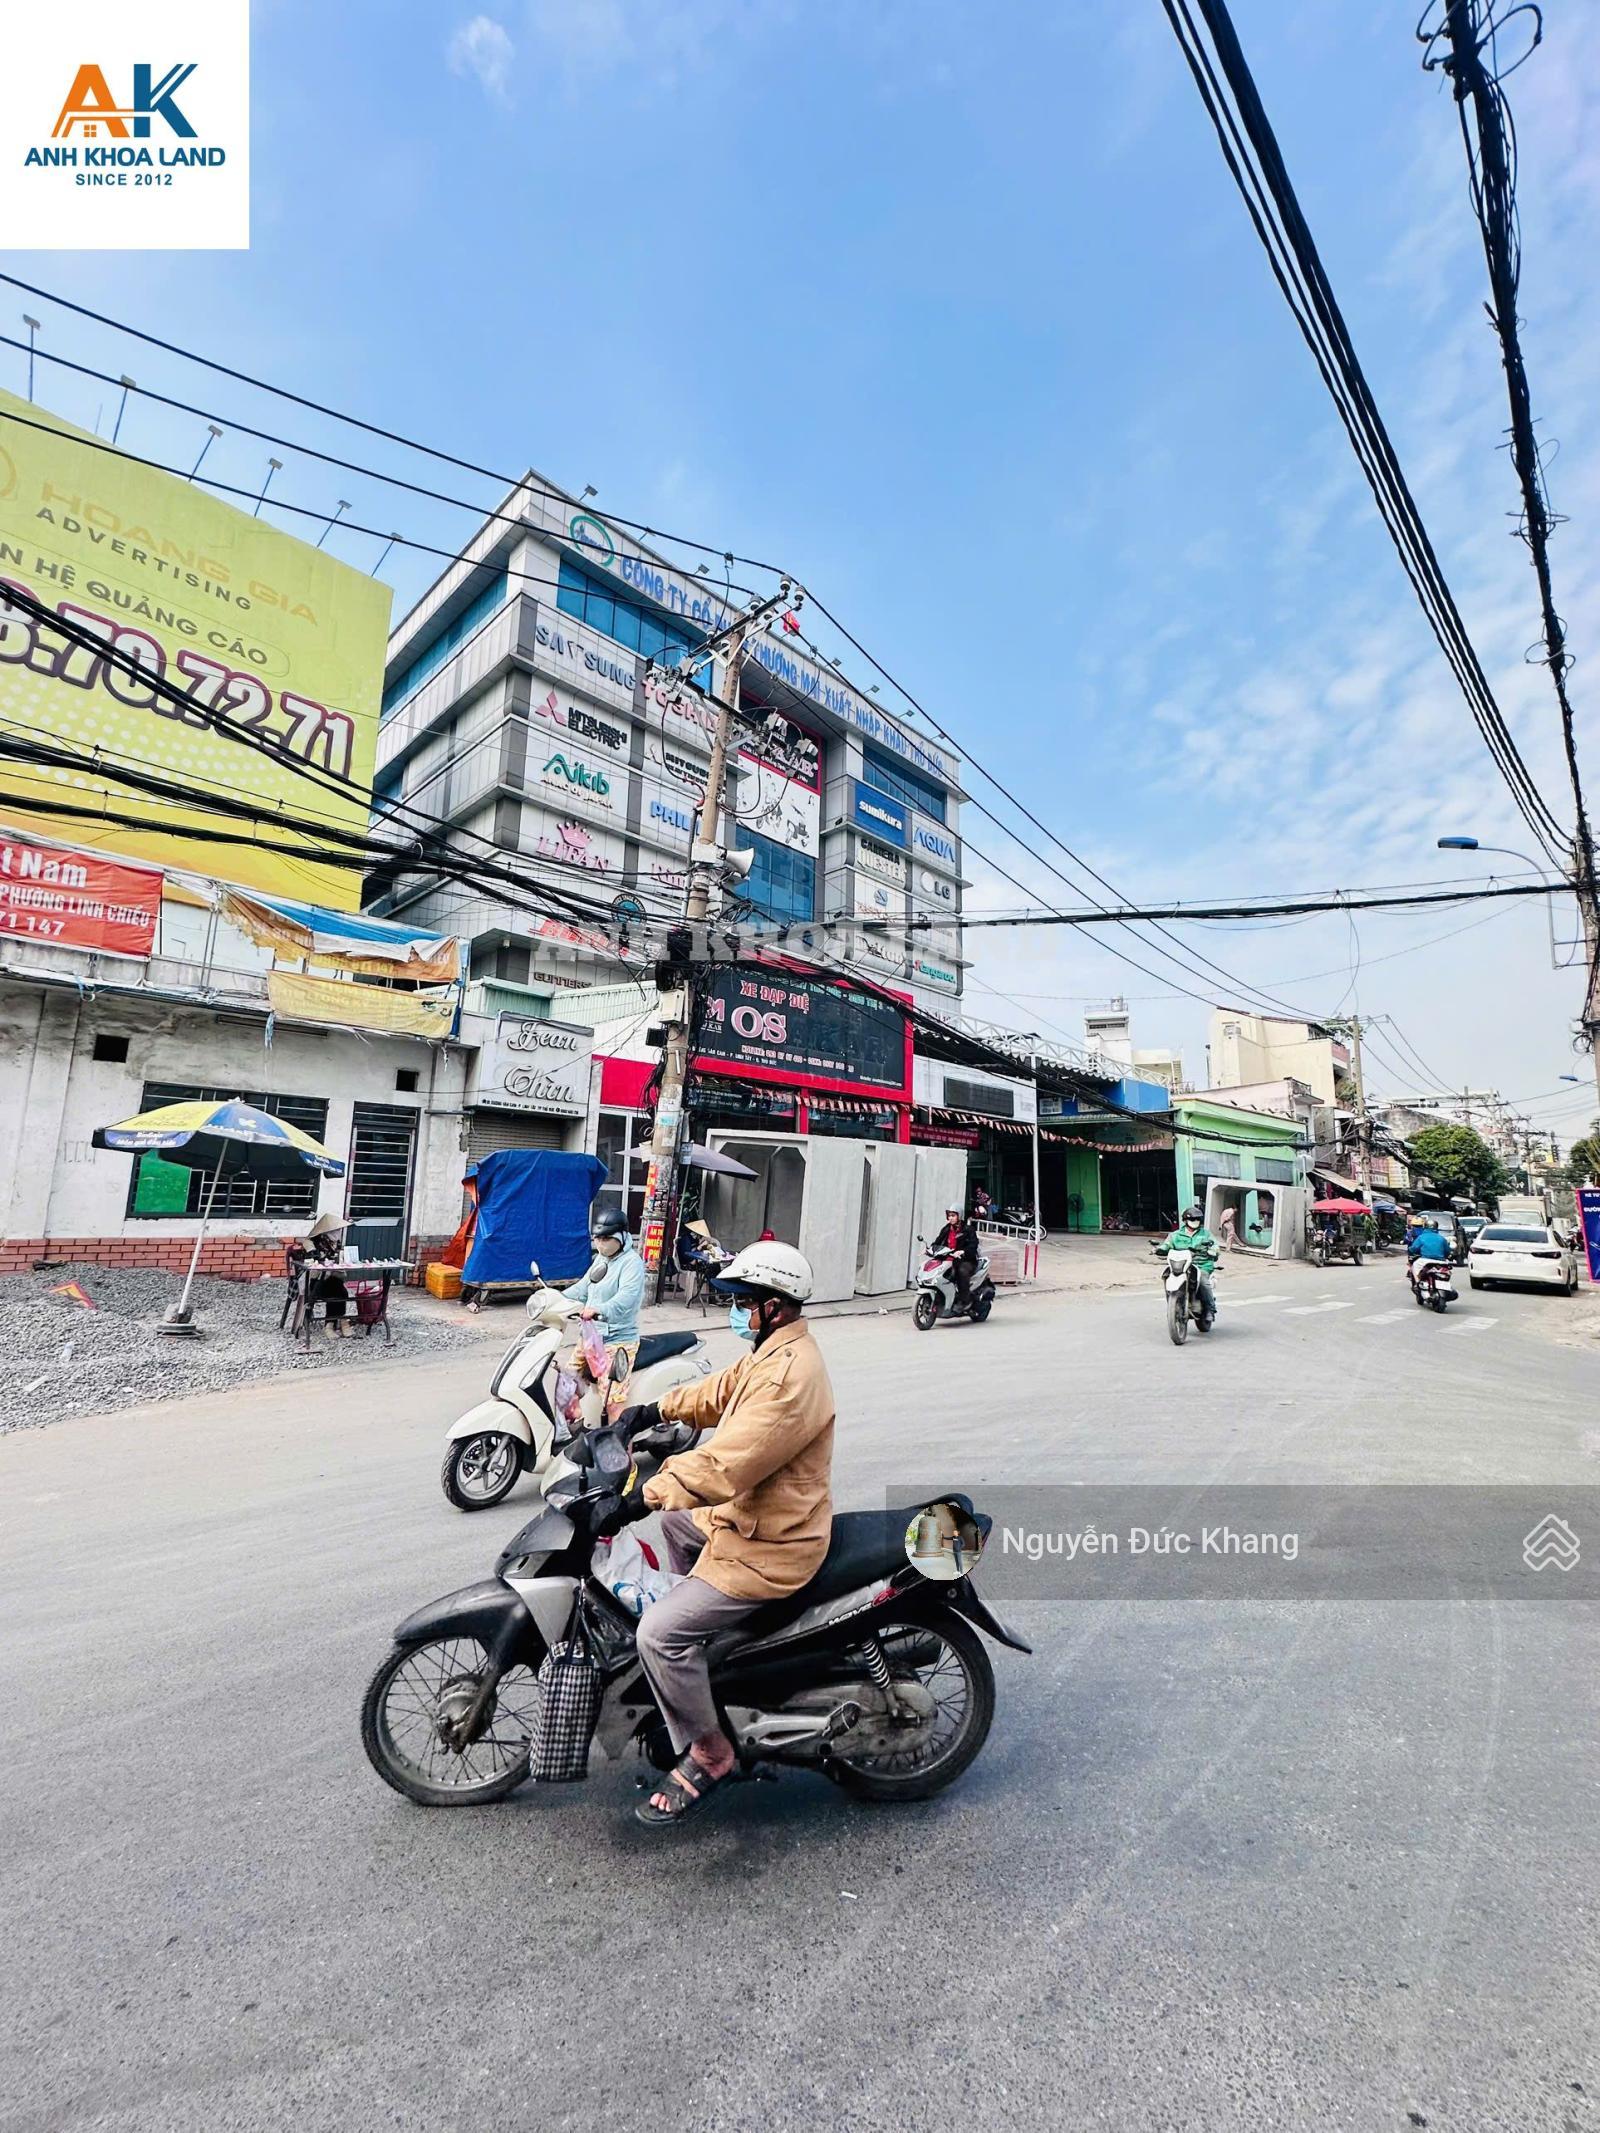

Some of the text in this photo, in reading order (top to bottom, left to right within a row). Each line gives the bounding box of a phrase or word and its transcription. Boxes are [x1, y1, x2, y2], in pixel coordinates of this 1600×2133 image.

[36, 507, 251, 611] ADVERTISING
[35, 562, 77, 590] HỆ
[86, 580, 199, 637] QUẢNG
[207, 630, 268, 665] CÁO
[249, 579, 319, 627] GIA
[668, 584, 689, 615] TY
[567, 719, 621, 750] ELECTRIC
[568, 706, 628, 744] MITSUBISHI
[858, 800, 903, 830] sumikura
[536, 836, 611, 874] LIFAN
[913, 825, 956, 863] AQUA
[20, 850, 88, 888] Nam
[934, 880, 951, 900] LG
[68, 897, 104, 919] LINH
[26, 916, 66, 936] 147
[740, 980, 757, 998] XE
[760, 986, 787, 1007] ĐẠP
